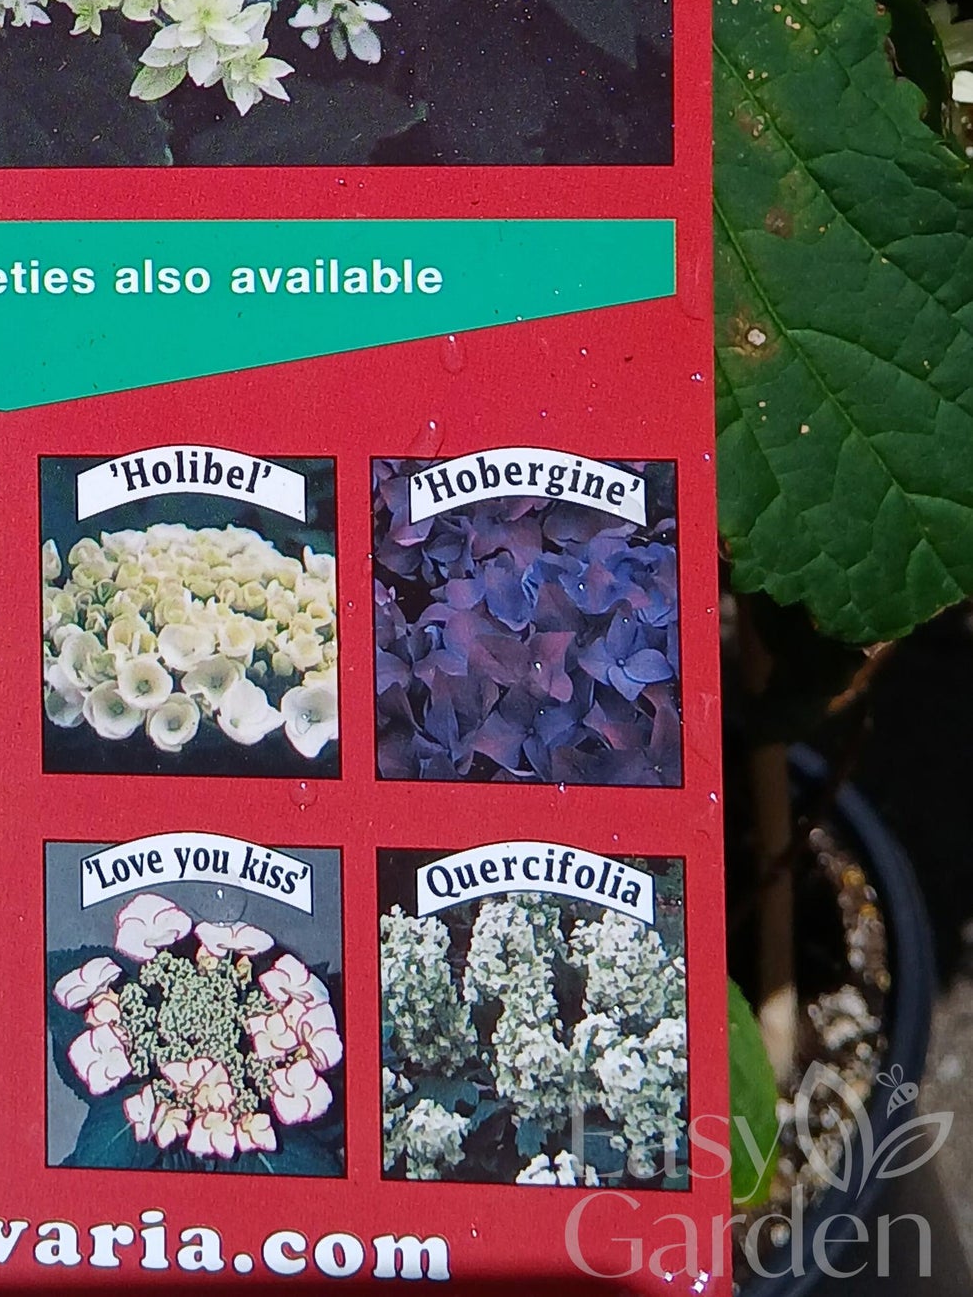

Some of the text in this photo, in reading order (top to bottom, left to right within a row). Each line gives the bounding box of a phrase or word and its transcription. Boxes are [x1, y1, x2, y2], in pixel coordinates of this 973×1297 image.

[113, 260, 211, 296] also
[229, 258, 443, 297] available
[173, 844, 229, 879] you
[426, 848, 643, 906] Quercifolia
